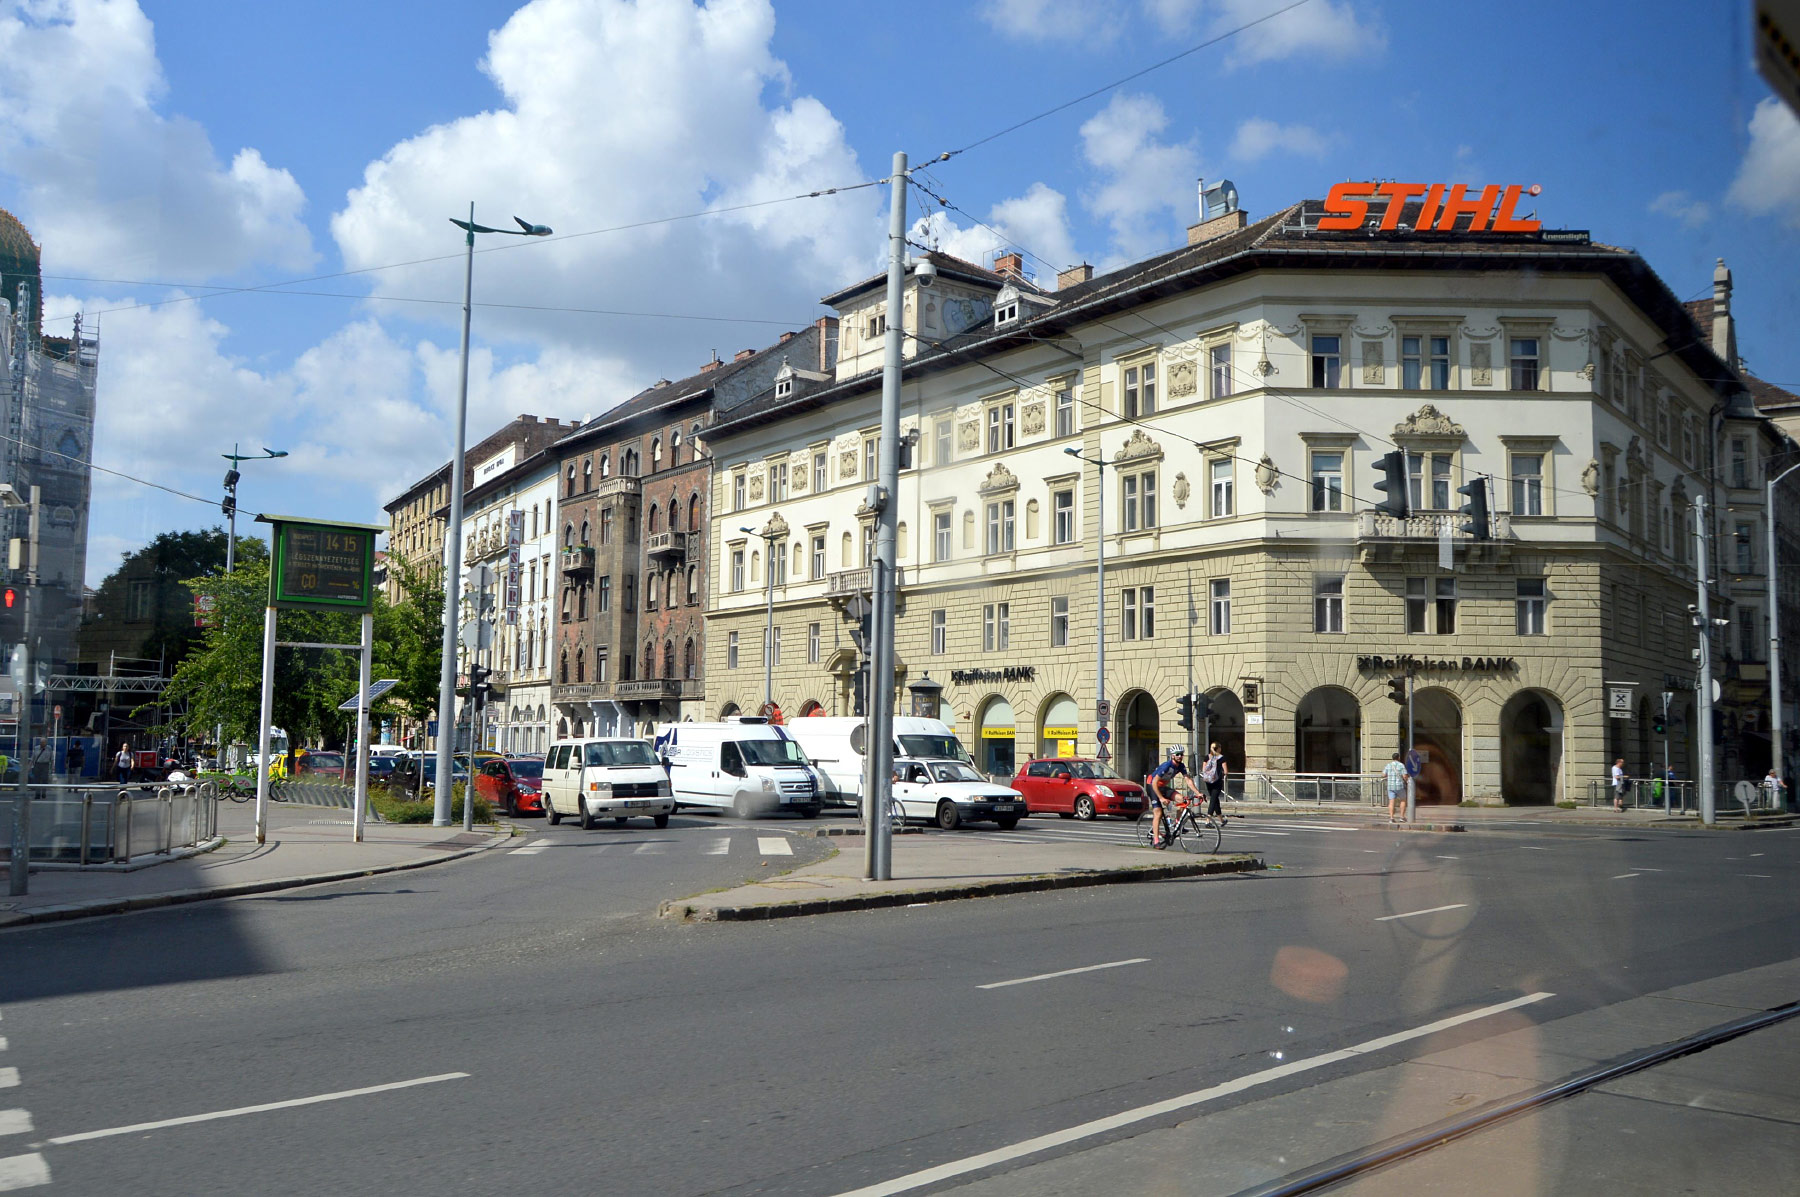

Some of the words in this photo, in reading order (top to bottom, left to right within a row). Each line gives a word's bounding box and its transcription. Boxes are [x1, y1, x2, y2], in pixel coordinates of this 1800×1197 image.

[1316, 183, 1542, 232] STIHL
[1547, 233, 1588, 241] neonlight
[326, 535, 340, 550] 14
[344, 536, 357, 552] 15
[301, 573, 316, 590] CO
[1373, 654, 1458, 671] Raiffeisen
[1462, 657, 1514, 671] BANK
[958, 668, 1002, 681] Raiffeisen
[1003, 667, 1033, 680] BANK
